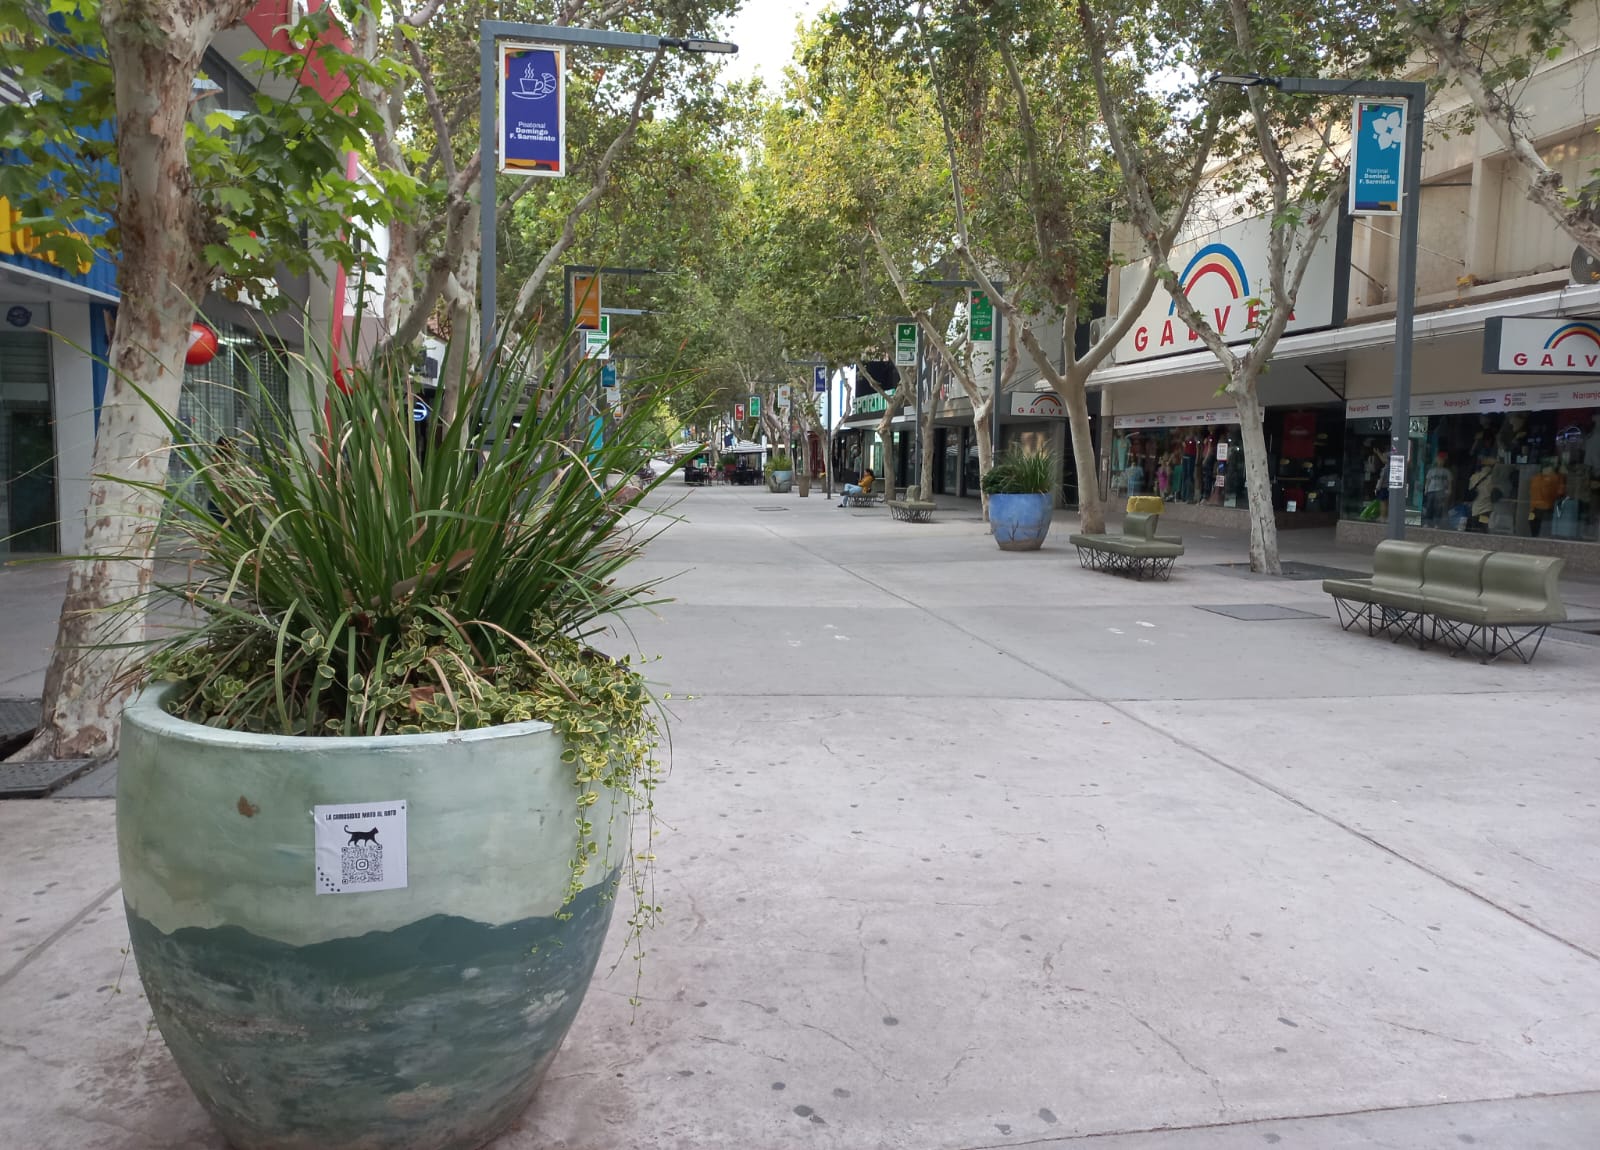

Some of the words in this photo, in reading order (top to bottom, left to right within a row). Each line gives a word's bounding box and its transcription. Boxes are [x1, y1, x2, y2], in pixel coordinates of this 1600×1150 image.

[515, 127, 549, 136] Domingo
[517, 133, 556, 142] Sarmiento
[1134, 299, 1296, 352] GALVE
[1513, 353, 1598, 367] GALV
[1503, 393, 1512, 407] 5
